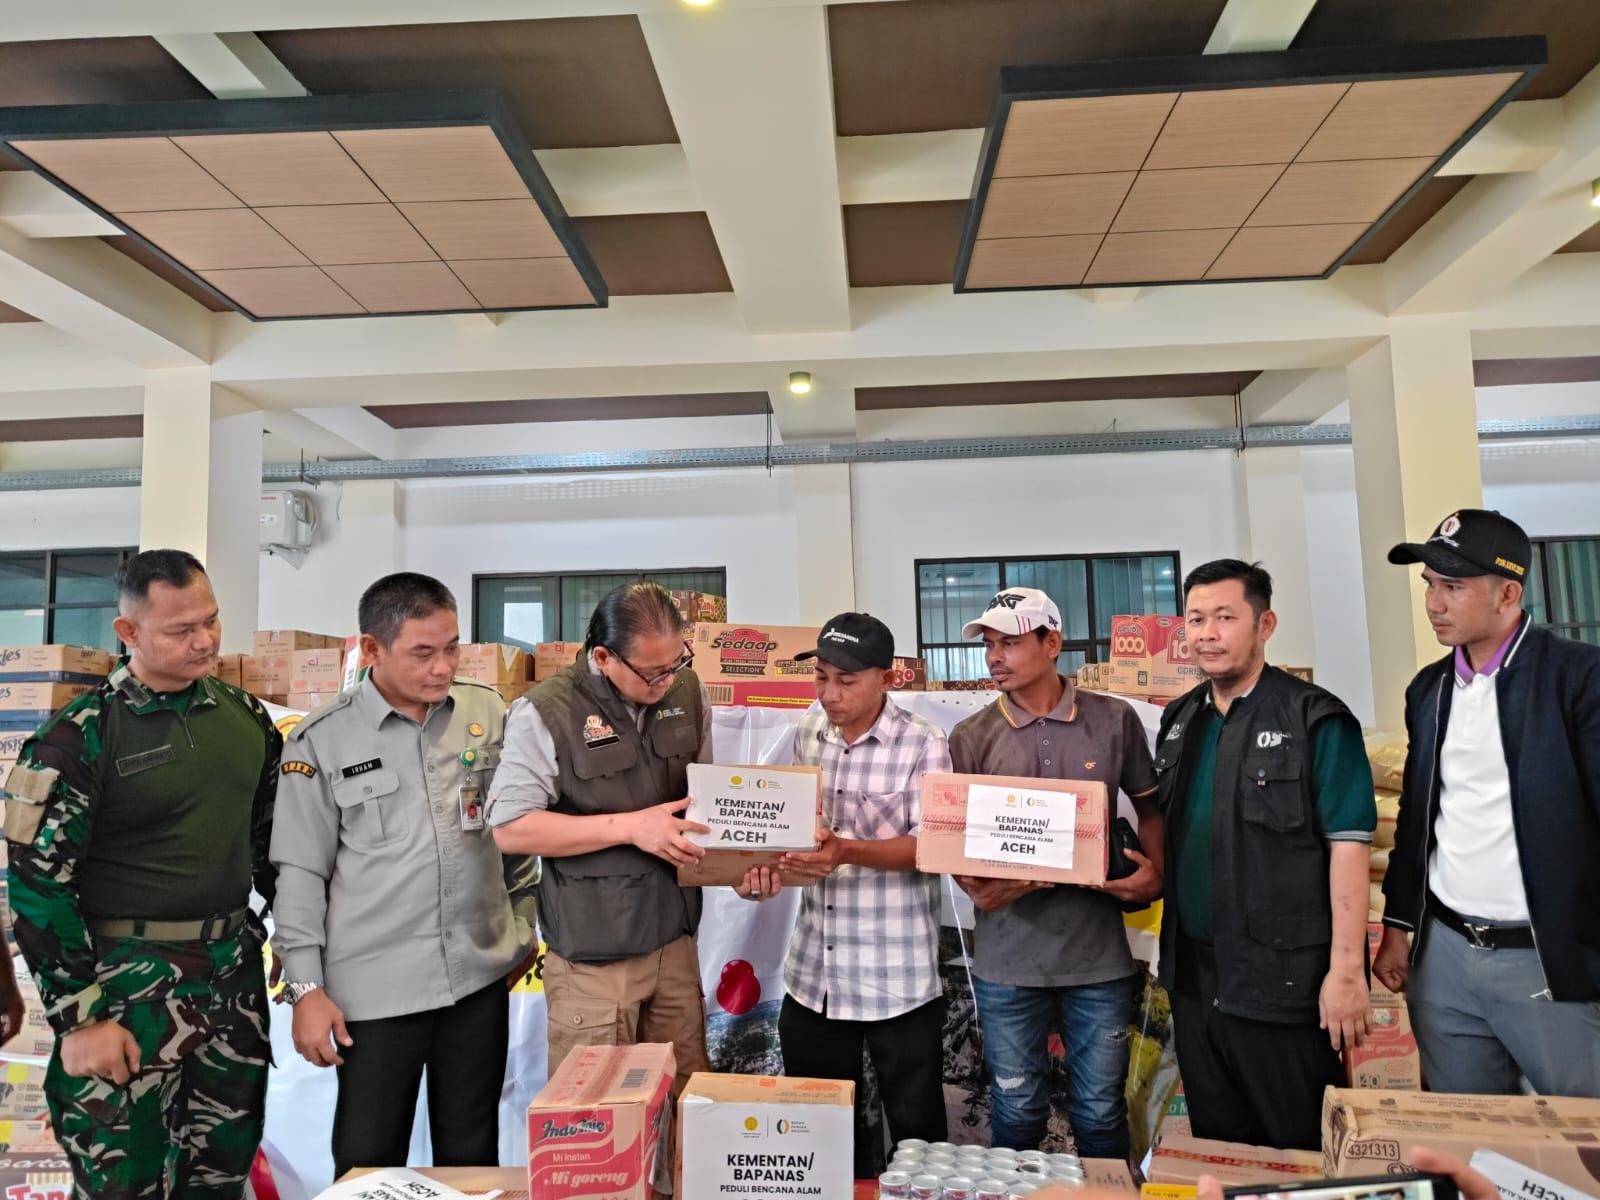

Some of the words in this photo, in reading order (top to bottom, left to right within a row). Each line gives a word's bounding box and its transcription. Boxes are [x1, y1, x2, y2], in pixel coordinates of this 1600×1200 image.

[986, 593, 1026, 612] PXG
[711, 637, 778, 653] Sedaap
[1114, 636, 1145, 654] 1000
[725, 666, 761, 674] SELECTION
[715, 797, 785, 813] KEMENTAN/
[720, 808, 777, 820] BAPANAS
[733, 820, 768, 828] BENCANA
[769, 822, 790, 830] ALAM
[995, 815, 1050, 829] KEMENTAN/
[720, 829, 767, 843] ACEH
[998, 824, 1044, 835] BAPANAS
[1000, 841, 1036, 854] ACEH
[552, 1152, 563, 1162] Mi
[565, 1152, 591, 1161] Instan
[1347, 1142, 1396, 1158] 4321313
[727, 1152, 815, 1171] KEMENTAN/
[571, 1172, 628, 1188] goreng
[734, 1169, 805, 1182] BAPANAS
[720, 1184, 750, 1193] PEDULI
[751, 1185, 794, 1194] BENCANA
[796, 1186, 822, 1195] ALAM
